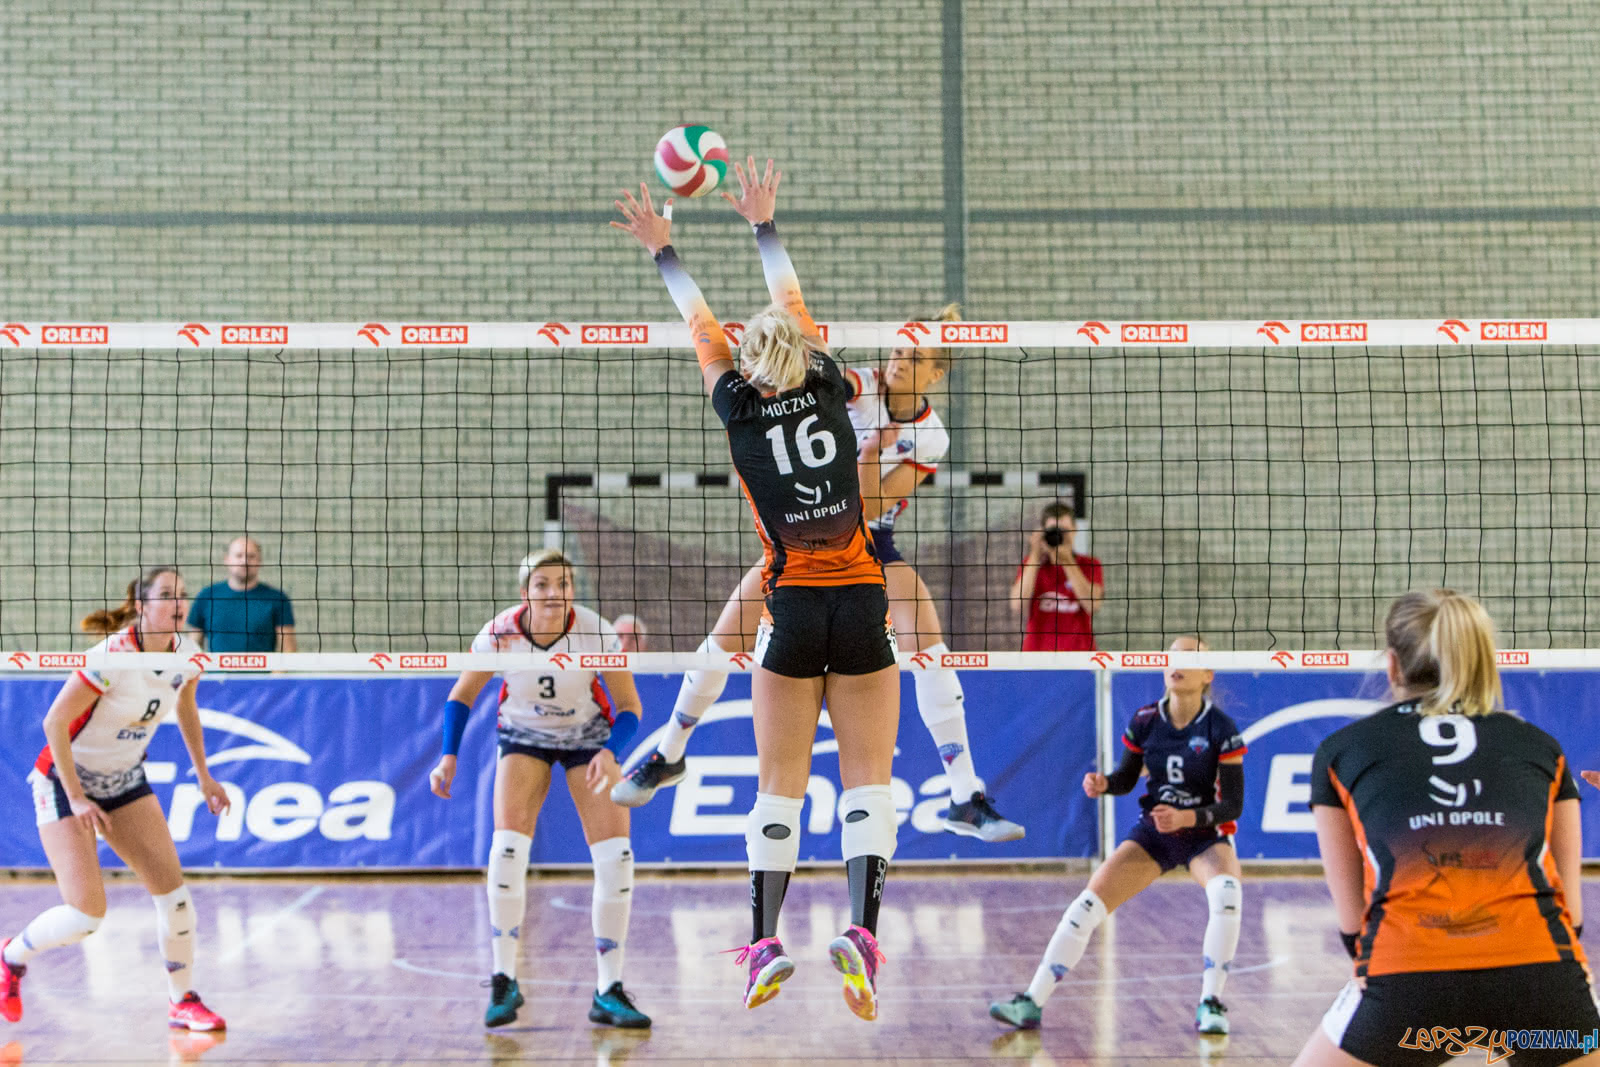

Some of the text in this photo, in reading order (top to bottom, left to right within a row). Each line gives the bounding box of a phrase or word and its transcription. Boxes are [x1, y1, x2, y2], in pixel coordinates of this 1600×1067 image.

[44, 327, 105, 343] ORLEN
[224, 327, 285, 343] ORLEN
[404, 327, 465, 343] ORLEN
[584, 327, 645, 343] ORLEN
[944, 326, 1005, 342] ORLEN
[1124, 326, 1185, 342] ORLEN
[1304, 325, 1364, 341] ORLEN
[1483, 324, 1544, 339] ORLEN
[761, 392, 817, 417] MOCZKO
[765, 413, 837, 475] 16
[785, 499, 848, 523] UNI OPOLE
[42, 656, 84, 667] ORLEN
[222, 656, 264, 667] ORLEN
[402, 656, 445, 667] ORLEN
[582, 656, 625, 667] ORLEN
[943, 655, 986, 667] ORLEN
[1123, 655, 1166, 666] ORLEN
[1304, 654, 1347, 665] ORLEN
[1496, 653, 1527, 664] RLEN
[538, 676, 556, 699] 3
[140, 699, 161, 721] 8
[1418, 714, 1477, 765] 9
[1166, 755, 1185, 783] 6
[98, 761, 396, 842] nea
[1409, 811, 1506, 830] UNI OPOLE
